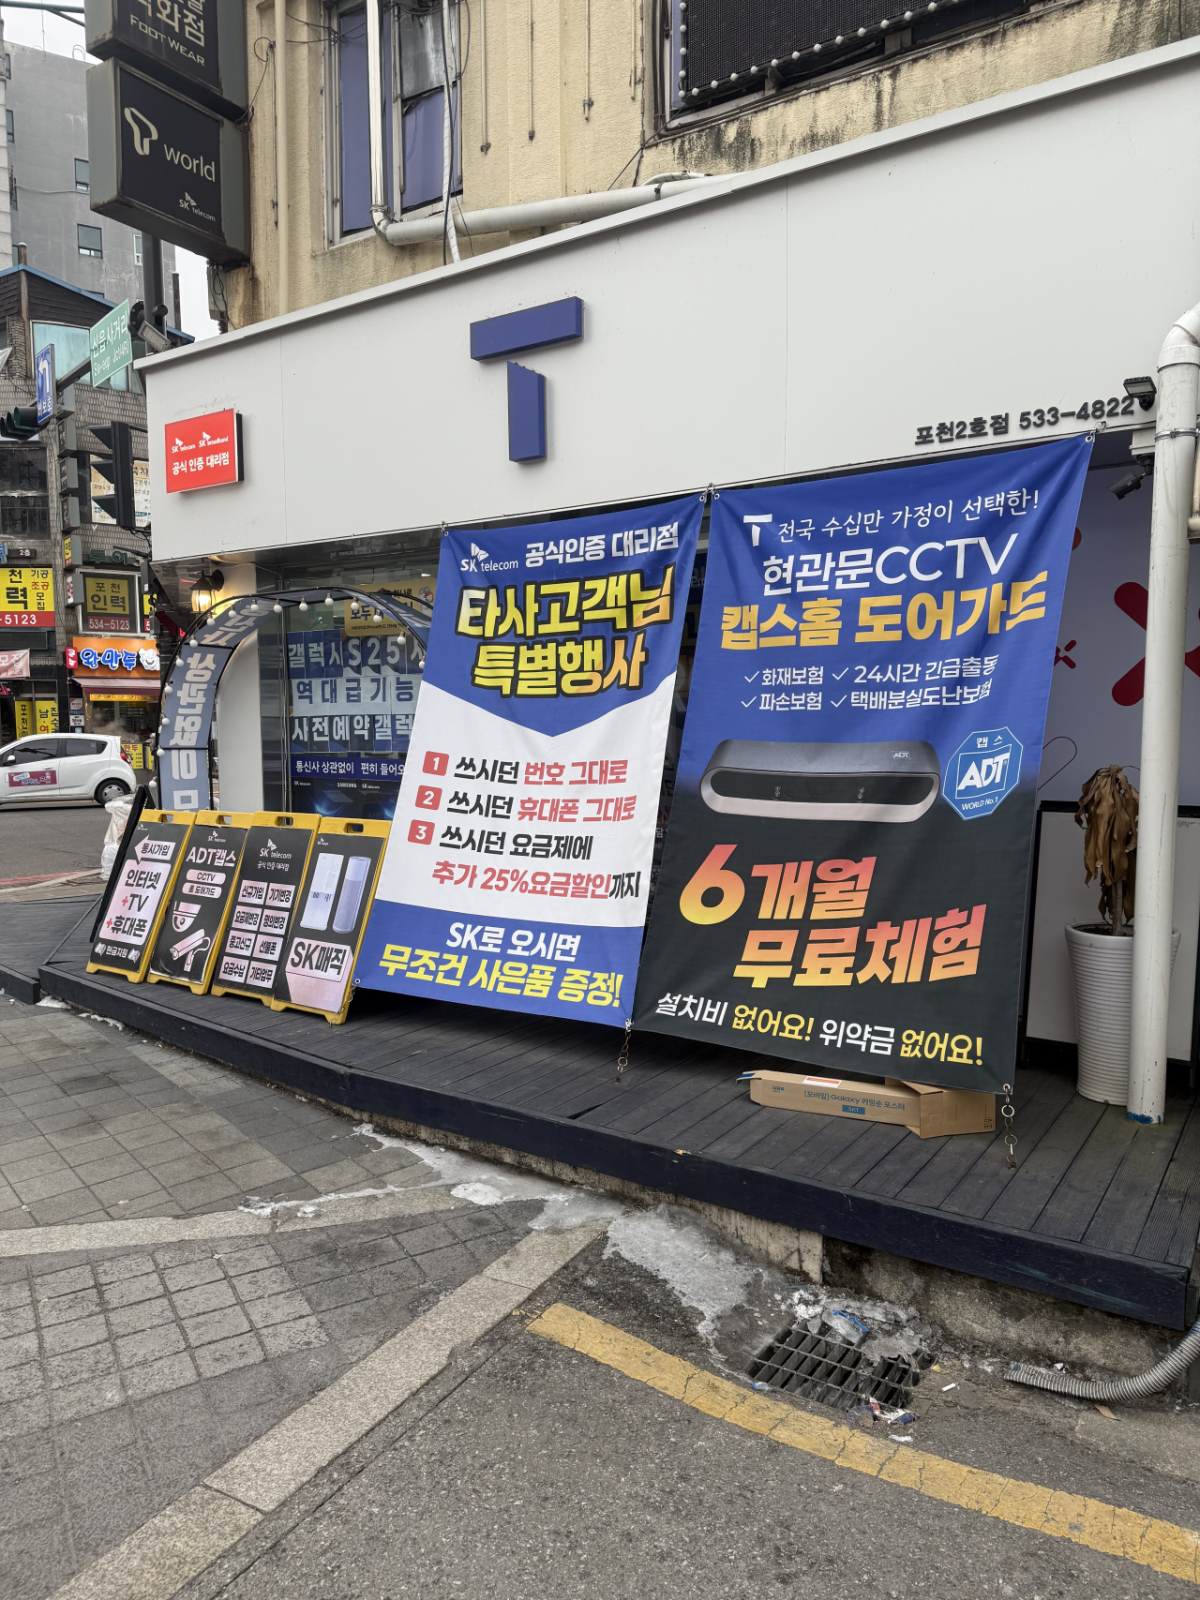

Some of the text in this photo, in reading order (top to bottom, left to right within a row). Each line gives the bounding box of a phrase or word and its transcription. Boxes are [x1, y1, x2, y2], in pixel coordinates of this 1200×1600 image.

[130, 14, 205, 67] FOOT WEAR
[163, 143, 216, 182] world
[179, 199, 216, 222] SK telecom
[470, 296, 582, 462] T
[915, 395, 1135, 446] 포천2호점 533-4822
[171, 445, 179, 454] SK
[198, 439, 206, 448] SK
[172, 451, 229, 475] 공식 인증 대리점
[778, 488, 1039, 543] 전국 수십만 가정이 선택한!
[525, 521, 679, 568] 공식인증 대리점
[460, 558, 519, 573] SK telecom
[763, 533, 1019, 597] 현관문CCTV
[31, 581, 50, 591] 조공
[95, 582, 120, 594] 포천
[456, 564, 675, 638] 타사고객님
[90, 594, 126, 612] 인력
[721, 570, 1048, 650] 캡스홈 도어가드
[88, 618, 130, 631] 534-5123
[80, 648, 138, 671] 왕만두
[473, 632, 647, 697] 특별행사
[761, 654, 999, 687] 화재보험 24시간 긴급출동
[758, 678, 993, 712] 파손보험 택배분실도난보험
[296, 760, 319, 773] 통신사
[321, 762, 354, 774] 상관없이
[360, 763, 377, 775] 편히
[454, 757, 519, 785] 쓰시던
[524, 762, 566, 786] 번호
[569, 760, 629, 785] 그대로
[957, 752, 1011, 791] ADT
[447, 791, 514, 819] 쓰시던
[517, 798, 580, 823] 휴대폰
[583, 795, 637, 822] 그대로
[961, 800, 985, 811] WORLD
[141, 843, 170, 857] 동시가입
[186, 846, 236, 867] ADT캡스
[259, 847, 292, 860] SK telecom
[439, 826, 506, 856] 쓰시던
[509, 834, 594, 860] 요금제에
[125, 869, 161, 890] 인터넷
[197, 872, 216, 882] CCTV
[241, 885, 265, 900] 신규가입
[432, 861, 477, 889] 추가
[480, 867, 641, 900] 25%요금할인까지
[446, 922, 581, 962] SK로 오시면
[733, 904, 987, 988] 무료체험
[290, 941, 345, 976] SK매직
[379, 943, 624, 1008] 무조건 사은품 증정!
[655, 992, 983, 1066] 설치비 없어요! 위약금 없어요!
[830, 1094, 861, 1105] Galaxy
